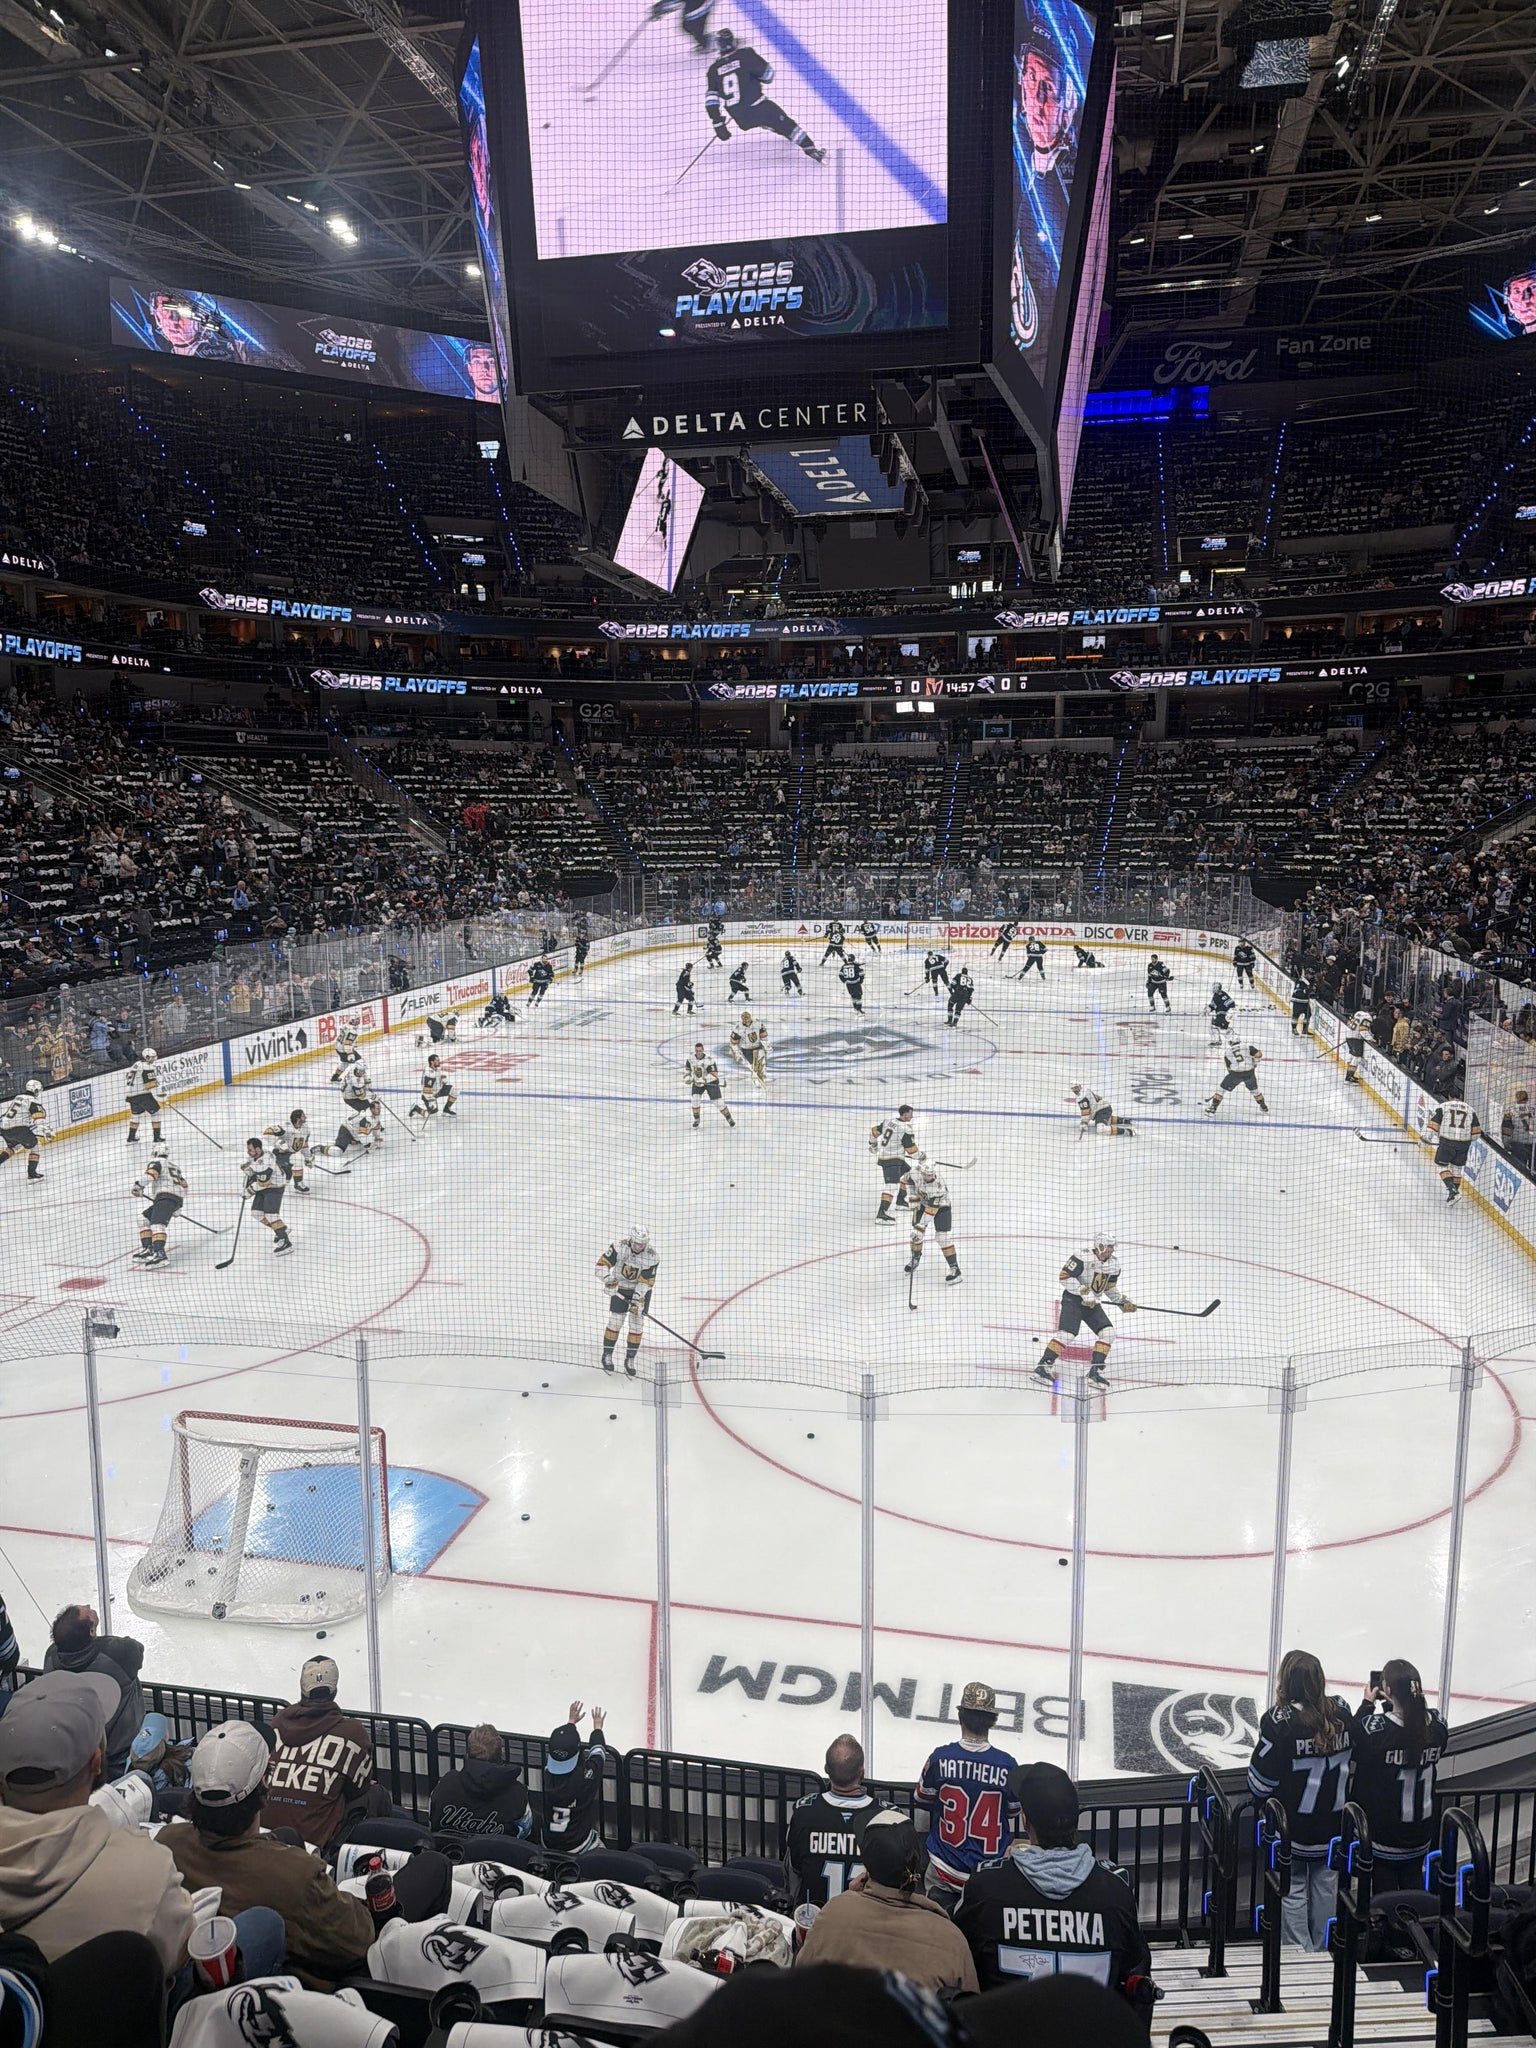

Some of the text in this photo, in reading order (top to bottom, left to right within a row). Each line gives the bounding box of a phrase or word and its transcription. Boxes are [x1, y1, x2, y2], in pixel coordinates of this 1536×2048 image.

[723, 73, 740, 107] 9
[723, 261, 794, 289] 2026
[675, 286, 804, 318] PLAYOFFS
[744, 315, 785, 327] DELTA
[339, 335, 373, 350] 2026
[1276, 335, 1371, 355] Fan Zone
[315, 343, 377, 363] PLAYOFFS
[347, 361, 370, 371] DELTA
[1153, 341, 1258, 385] Ford
[653, 402, 867, 435] DELTA CENTER
[12, 555, 44, 570] DELTA
[1473, 578, 1527, 600] 2026
[225, 593, 268, 613] 2026
[270, 600, 352, 622] PLAYOFFS
[395, 616, 428, 626] DELTA
[1022, 611, 1069, 627] 2026
[1071, 607, 1161, 626] PLAYOFFS
[1208, 606, 1244, 616] DELTA
[625, 624, 669, 638] 2026
[671, 623, 751, 639] PLAYOFFS
[792, 624, 824, 633] DELTA
[5, 634, 83, 663] PLAYOFFS
[121, 655, 150, 668] DELTA
[338, 673, 382, 690] 2026
[384, 676, 468, 695] PLAYOFFS
[510, 685, 543, 695] DELTA
[1001, 677, 1010, 691] 0
[1020, 681, 1026, 690] 0
[1138, 671, 1187, 687] 2026
[1189, 667, 1282, 686] PLAYOFFS
[1330, 665, 1368, 677] DELTA
[734, 684, 777, 699] 2026
[779, 682, 859, 698] PLAYOFFS
[895, 685, 901, 693] 0
[911, 680, 920, 693] 0
[946, 682, 974, 693] 14:57
[579, 702, 615, 718] G2G
[937, 923, 1001, 939] verizon
[1084, 926, 1149, 941] DISCOVER
[1153, 930, 1181, 943] ESPN
[1209, 937, 1230, 950] PEPSI
[842, 967, 856, 979] 98
[960, 976, 974, 989] 82
[155, 1052, 209, 1076] RAIG SWAPP
[1231, 1049, 1245, 1063] 5
[162, 1065, 204, 1084] ASSOCIATES
[71, 1087, 90, 1101] BUILT
[1448, 1108, 1468, 1129] 17
[881, 1128, 894, 1147] 9
[697, 1654, 1087, 1742] BETMGM
[938, 1758, 1009, 1787] MATTHEWS
[1396, 1761, 1434, 1823] 11
[550, 1806, 571, 1833] 9
[938, 1783, 1004, 1855] 34
[809, 1832, 861, 1856] GUENT
[1003, 1907, 1105, 1946] PETERKA
